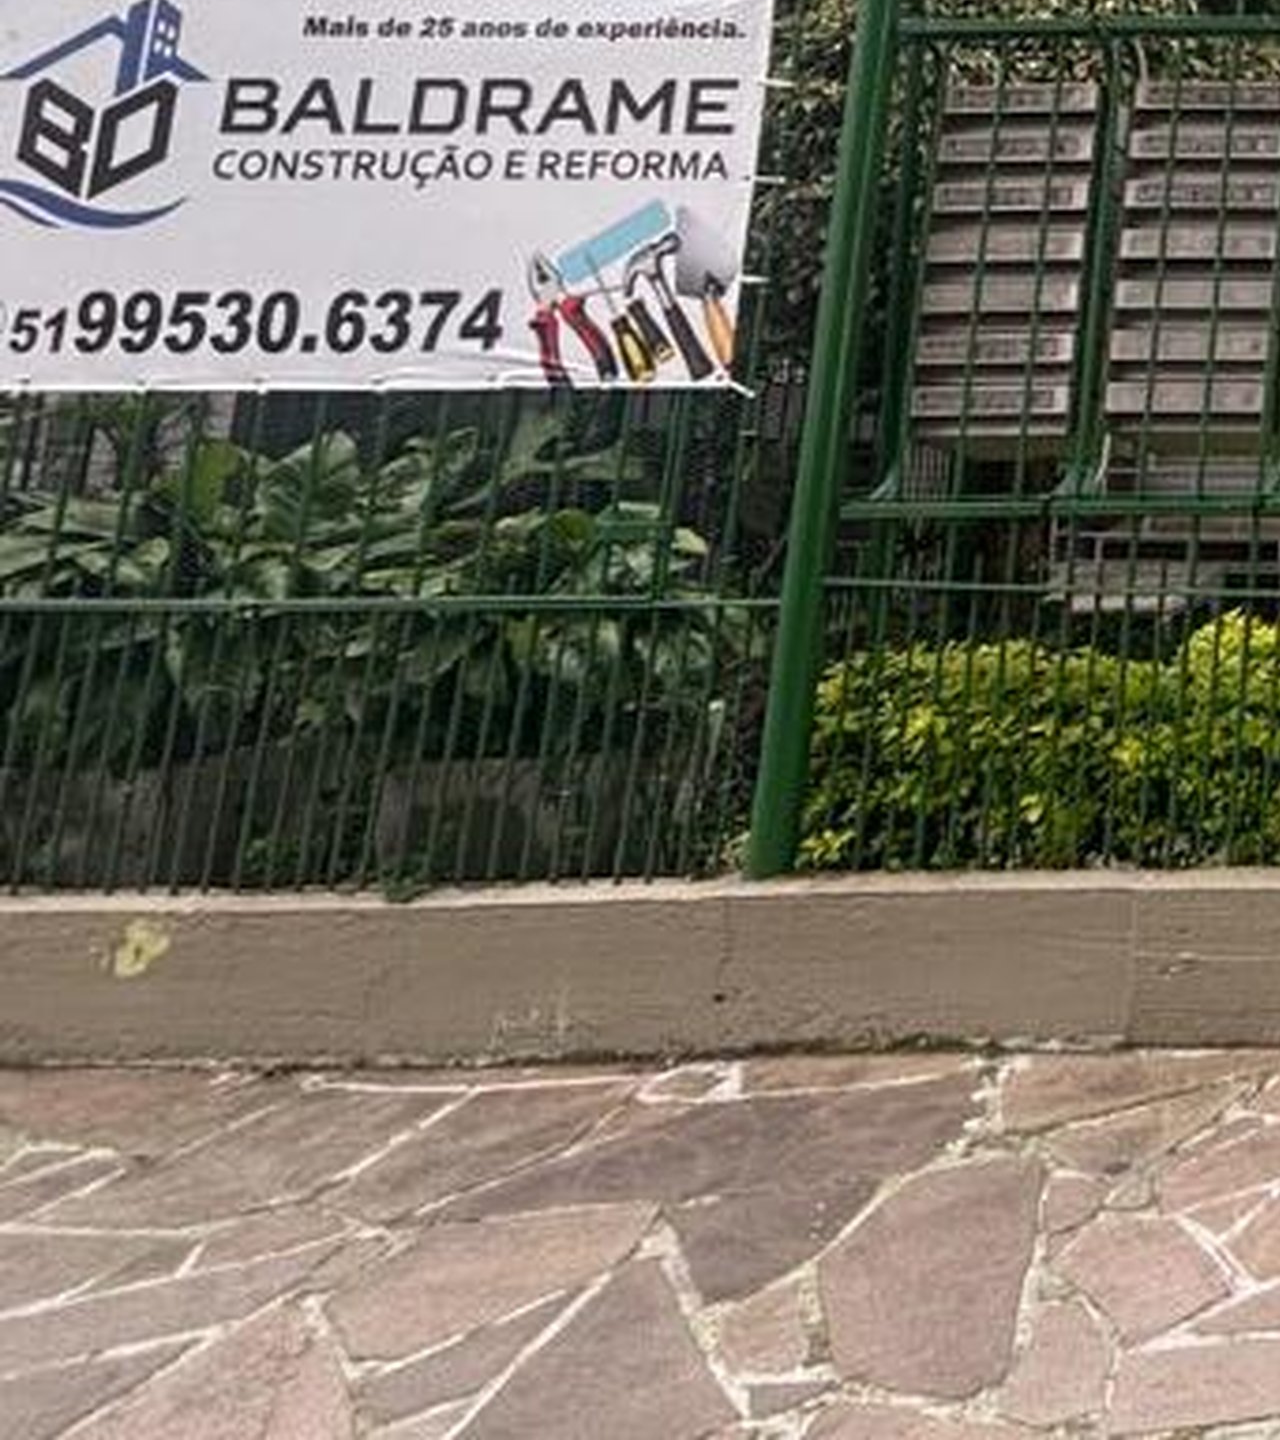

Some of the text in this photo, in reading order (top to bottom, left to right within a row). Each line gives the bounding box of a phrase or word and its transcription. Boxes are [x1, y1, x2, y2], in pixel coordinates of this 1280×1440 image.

[302, 16, 747, 42] Mais de 25 anos de experiência.
[219, 77, 740, 136] BALDRAME
[212, 144, 729, 189] CONSTRUÇÃO E REFORMA
